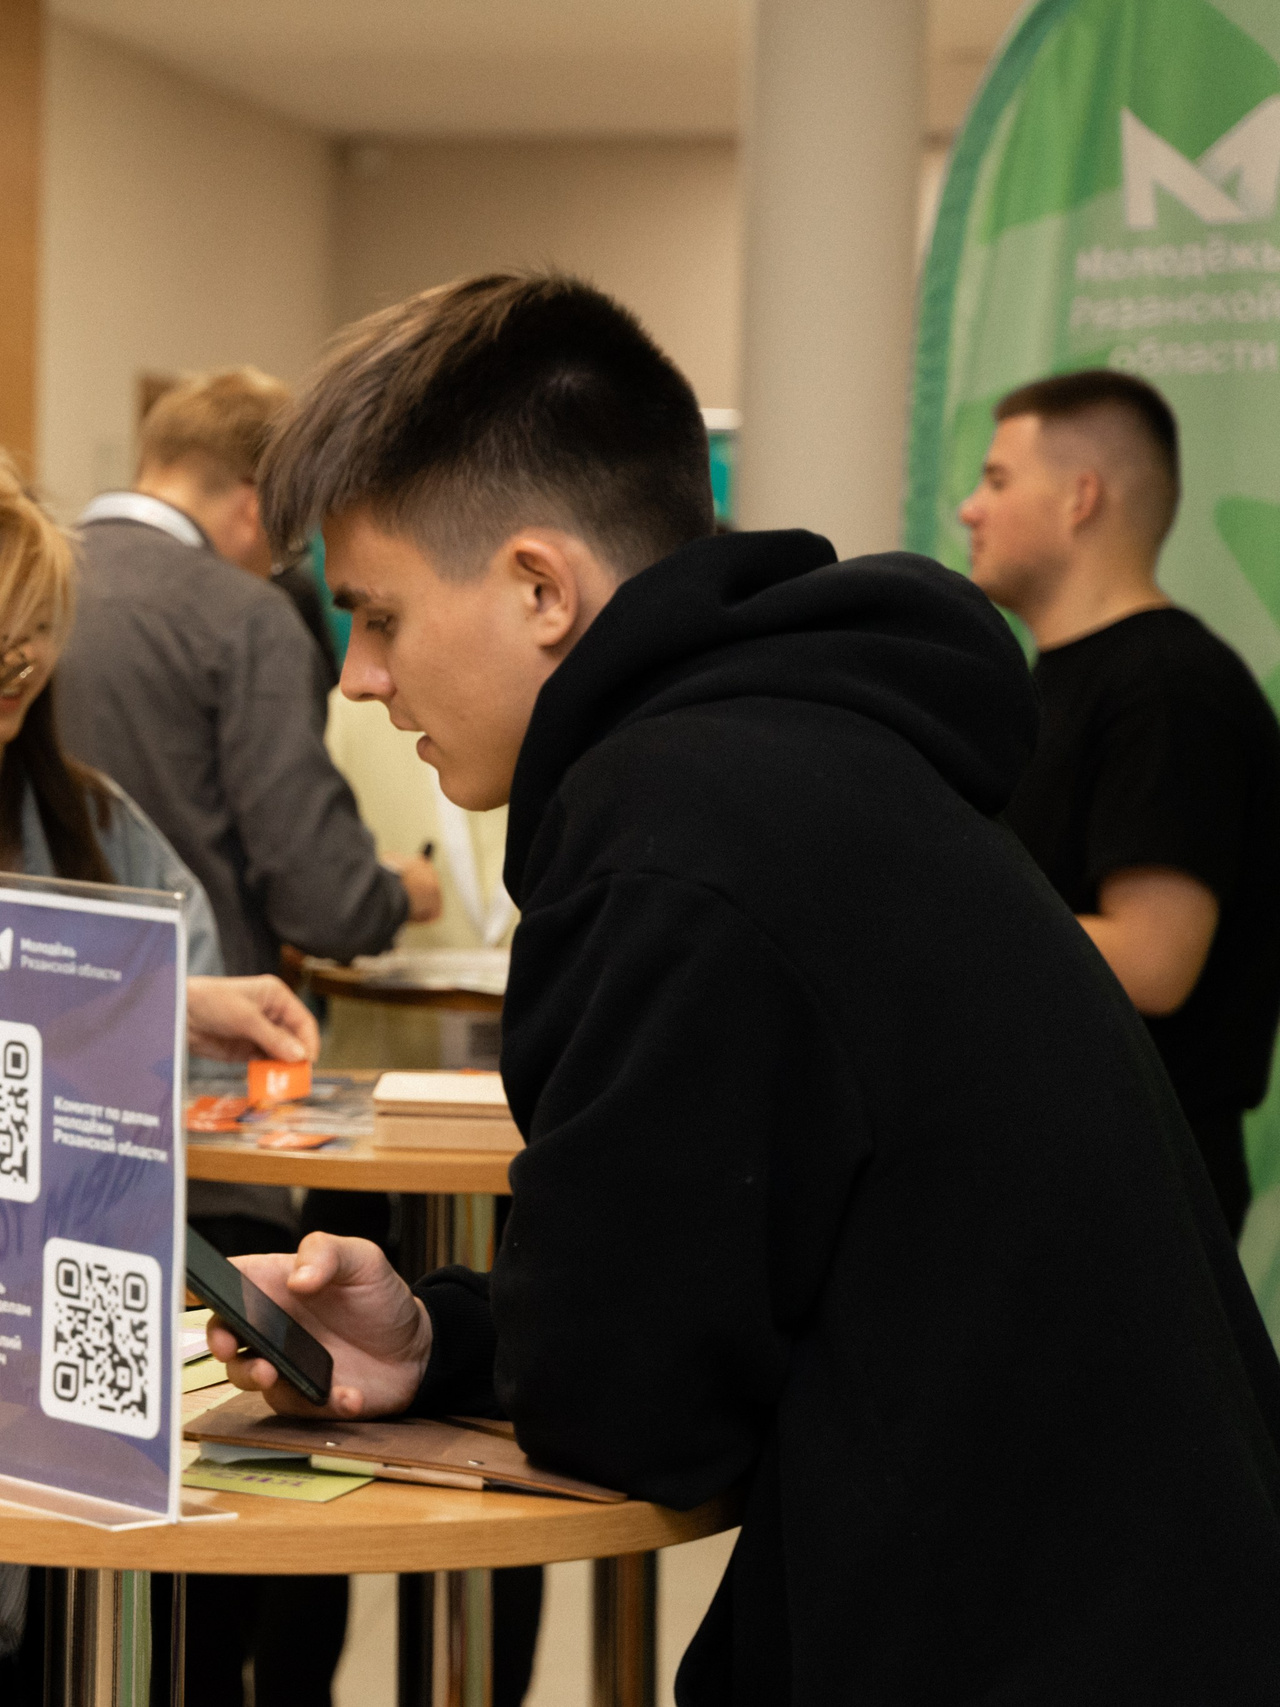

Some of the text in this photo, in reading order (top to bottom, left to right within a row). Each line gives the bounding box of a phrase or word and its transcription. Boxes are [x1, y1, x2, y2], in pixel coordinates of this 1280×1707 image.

[20, 954, 122, 982] Рязанской области
[52, 1114, 115, 1136] молодёжи
[53, 1095, 160, 1128] Комитет по делам
[52, 1128, 168, 1163] Рязанской области
